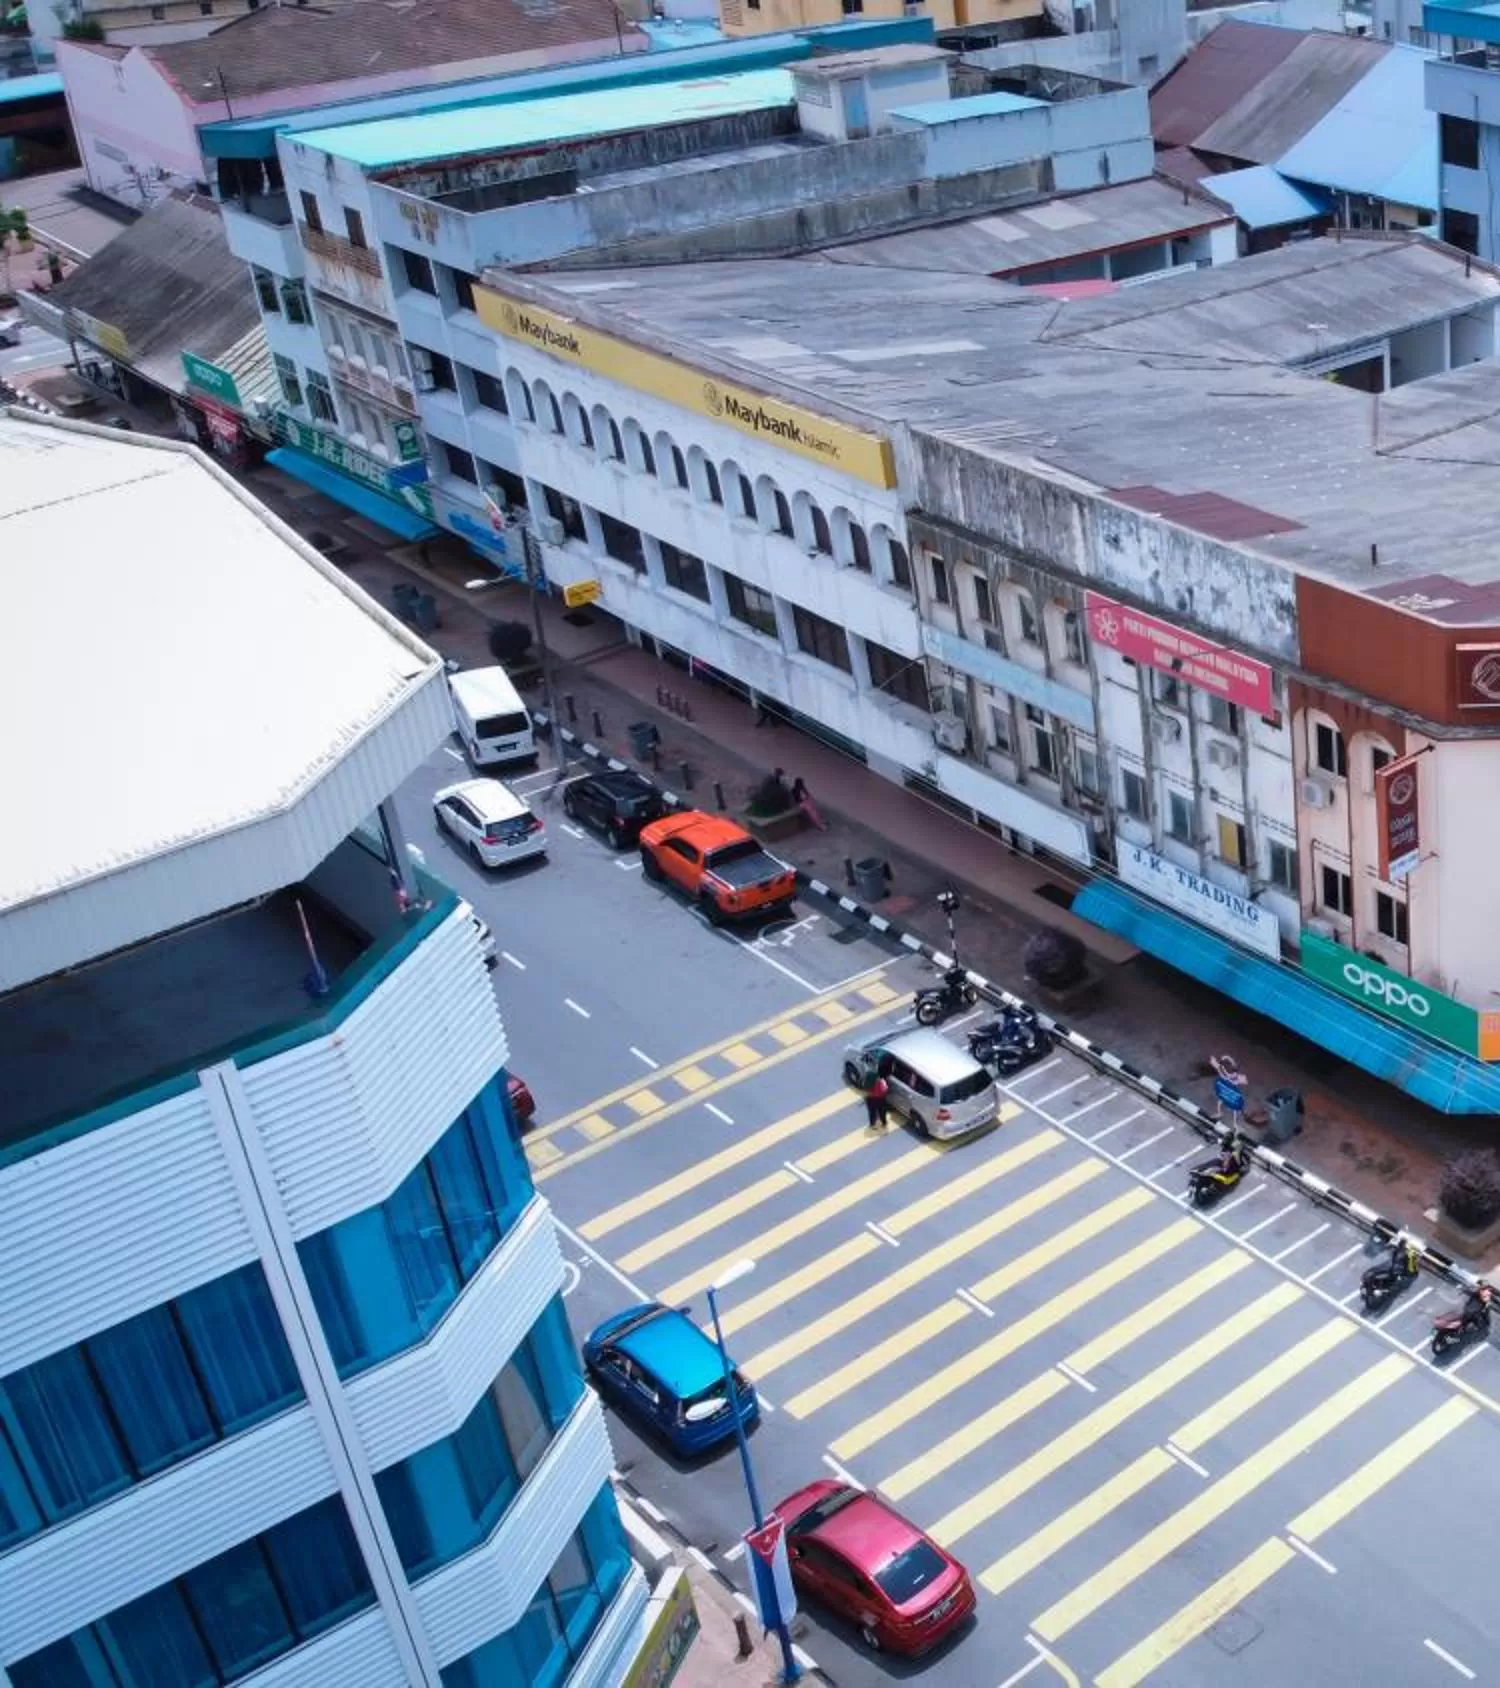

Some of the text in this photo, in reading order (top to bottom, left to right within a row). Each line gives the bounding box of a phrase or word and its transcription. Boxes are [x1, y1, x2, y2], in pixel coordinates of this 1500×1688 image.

[518, 314, 581, 356] Maybank
[725, 395, 804, 444] Maybank
[1175, 868, 1260, 923] TRADING
[1343, 963, 1431, 1017] oppo
